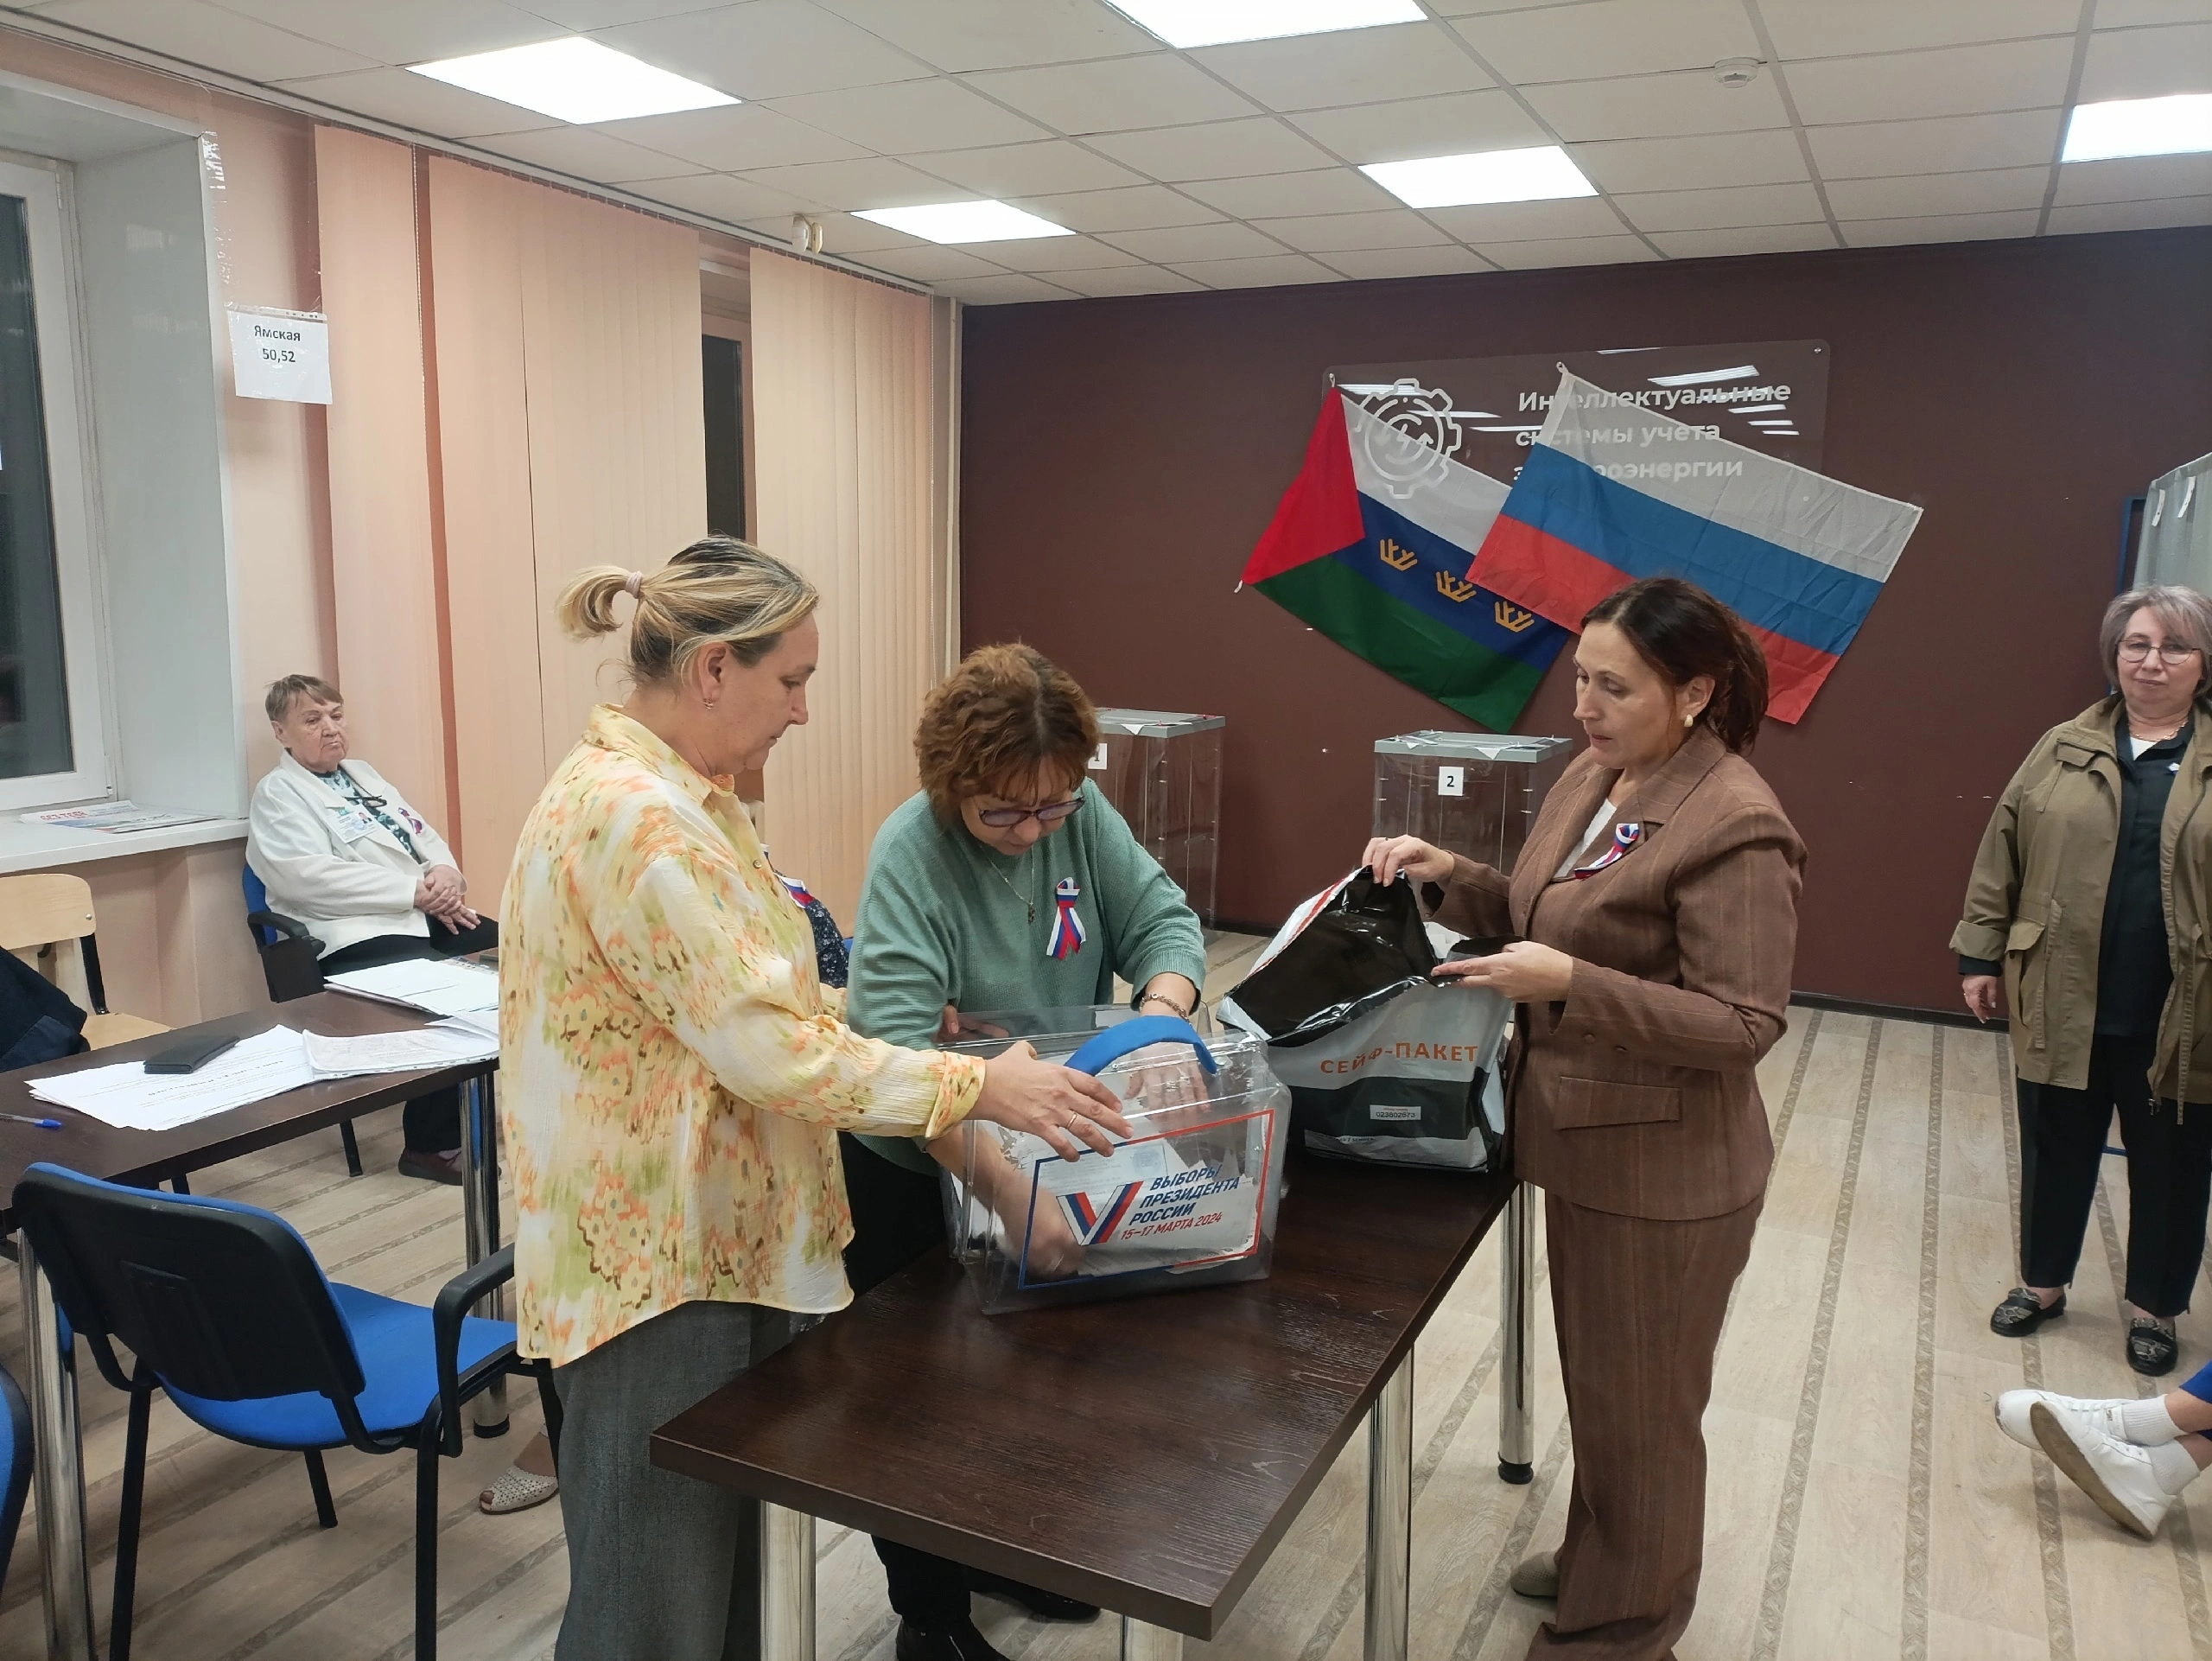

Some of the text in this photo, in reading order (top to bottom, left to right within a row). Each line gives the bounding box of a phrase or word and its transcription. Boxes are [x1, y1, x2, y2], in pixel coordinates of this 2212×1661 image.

[254, 325, 301, 341] Ямская
[263, 348, 296, 363] 50,52
[1518, 385, 1791, 412] Инеллектуальные
[1639, 424, 1720, 448] учета
[1446, 775, 1455, 787] 2
[1320, 1041, 1478, 1074] СЕЙФ-ПАКЕТ
[1149, 1164, 1224, 1191] ВЫБОРЫ
[1139, 1176, 1241, 1209] ПРЕЗИДЕНТА
[1128, 1202, 1197, 1226] РОССИИ
[1154, 1218, 1194, 1235] МАРТА
[1194, 1212, 1223, 1227] 2024
